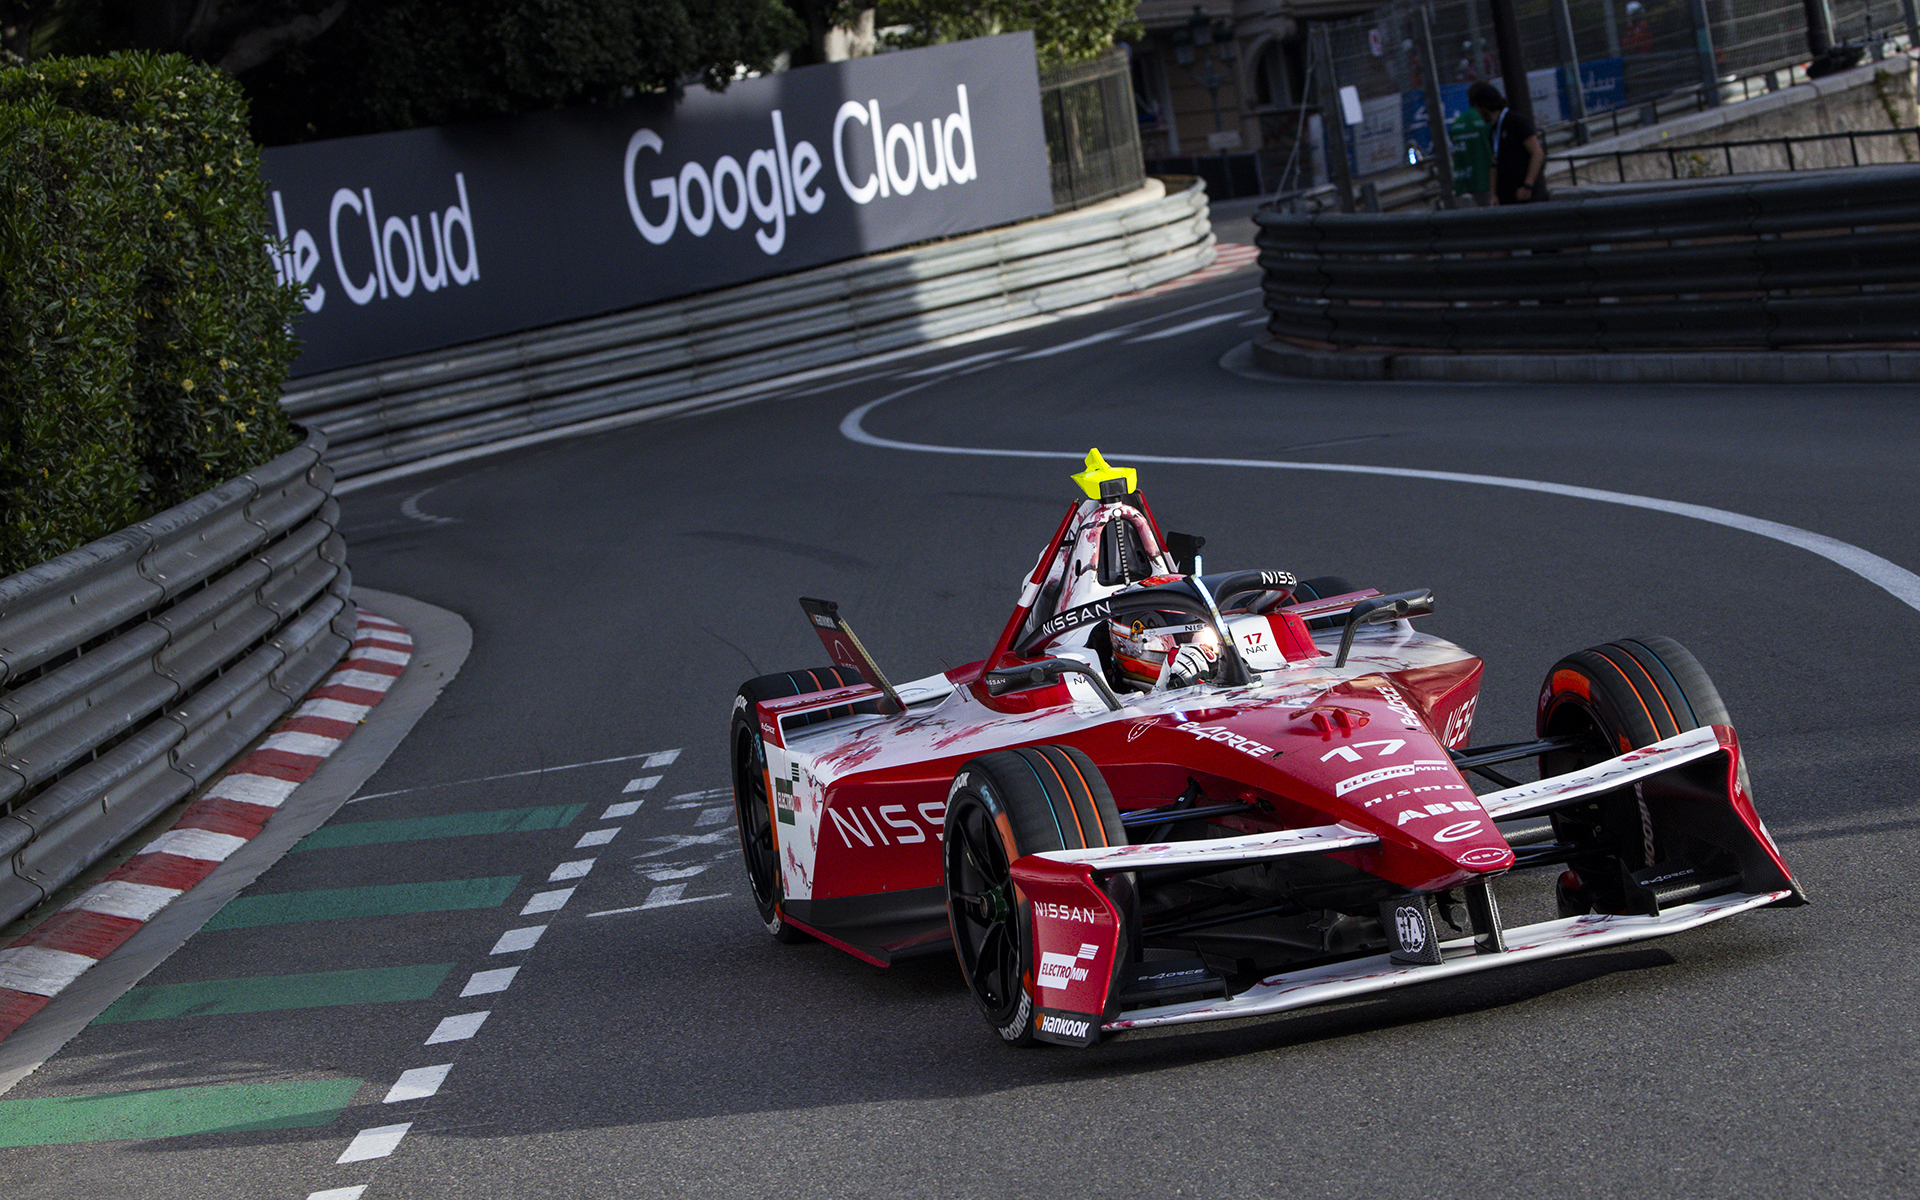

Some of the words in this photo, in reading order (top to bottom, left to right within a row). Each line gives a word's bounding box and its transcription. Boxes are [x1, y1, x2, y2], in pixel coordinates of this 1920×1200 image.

[623, 110, 825, 255] Google
[833, 83, 977, 204] Cloud
[329, 172, 480, 305] Cloud
[1041, 600, 1112, 636] NISSAN
[1243, 632, 1263, 645] 17
[1246, 644, 1269, 655] NAT
[1320, 739, 1407, 763] 17
[1364, 784, 1465, 808] nismo
[1397, 801, 1482, 826] ABB
[1034, 901, 1095, 924] NISSAN
[1041, 963, 1090, 982] ELECTROMIN
